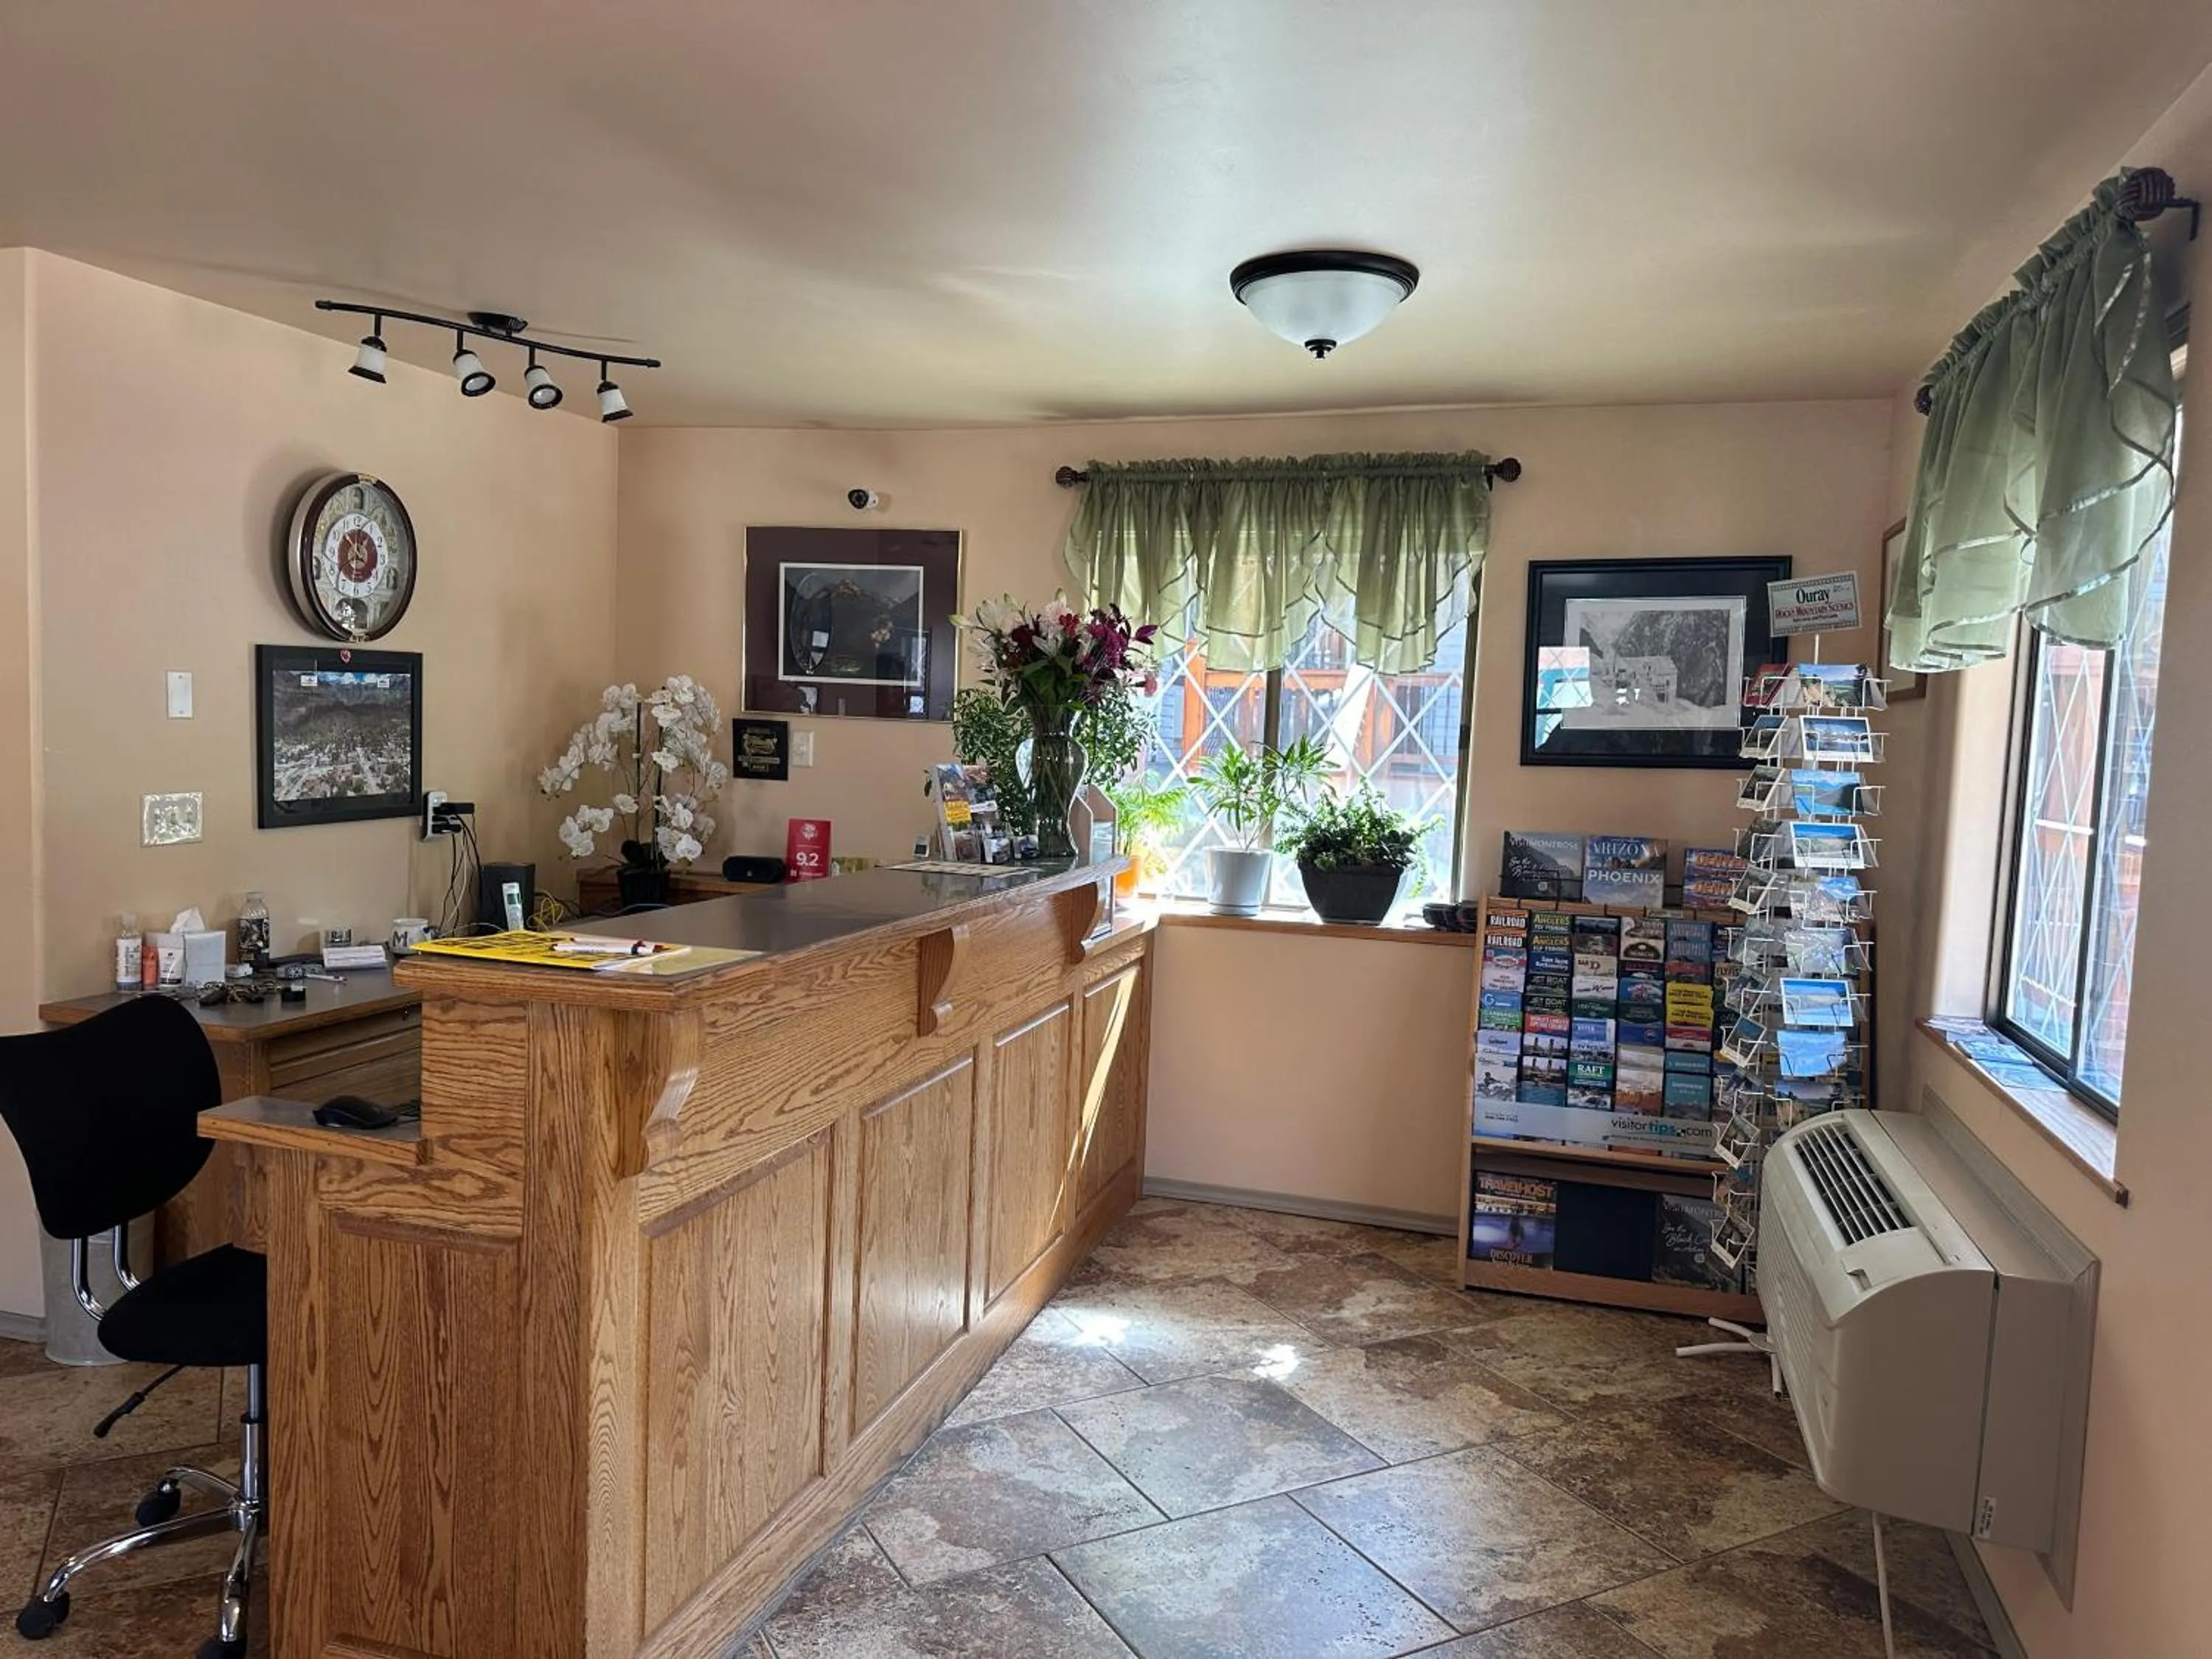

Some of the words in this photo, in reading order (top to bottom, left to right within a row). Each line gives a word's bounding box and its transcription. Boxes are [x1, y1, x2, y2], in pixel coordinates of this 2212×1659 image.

[1796, 588, 1829, 604] Ouray
[1587, 869, 1660, 885] PHOENIX
[1490, 914, 1526, 928] RAILROAD
[1486, 934, 1523, 947] RAILROAD
[1577, 1063, 1606, 1075] RAFT
[1611, 1116, 1713, 1138] visitortips.com
